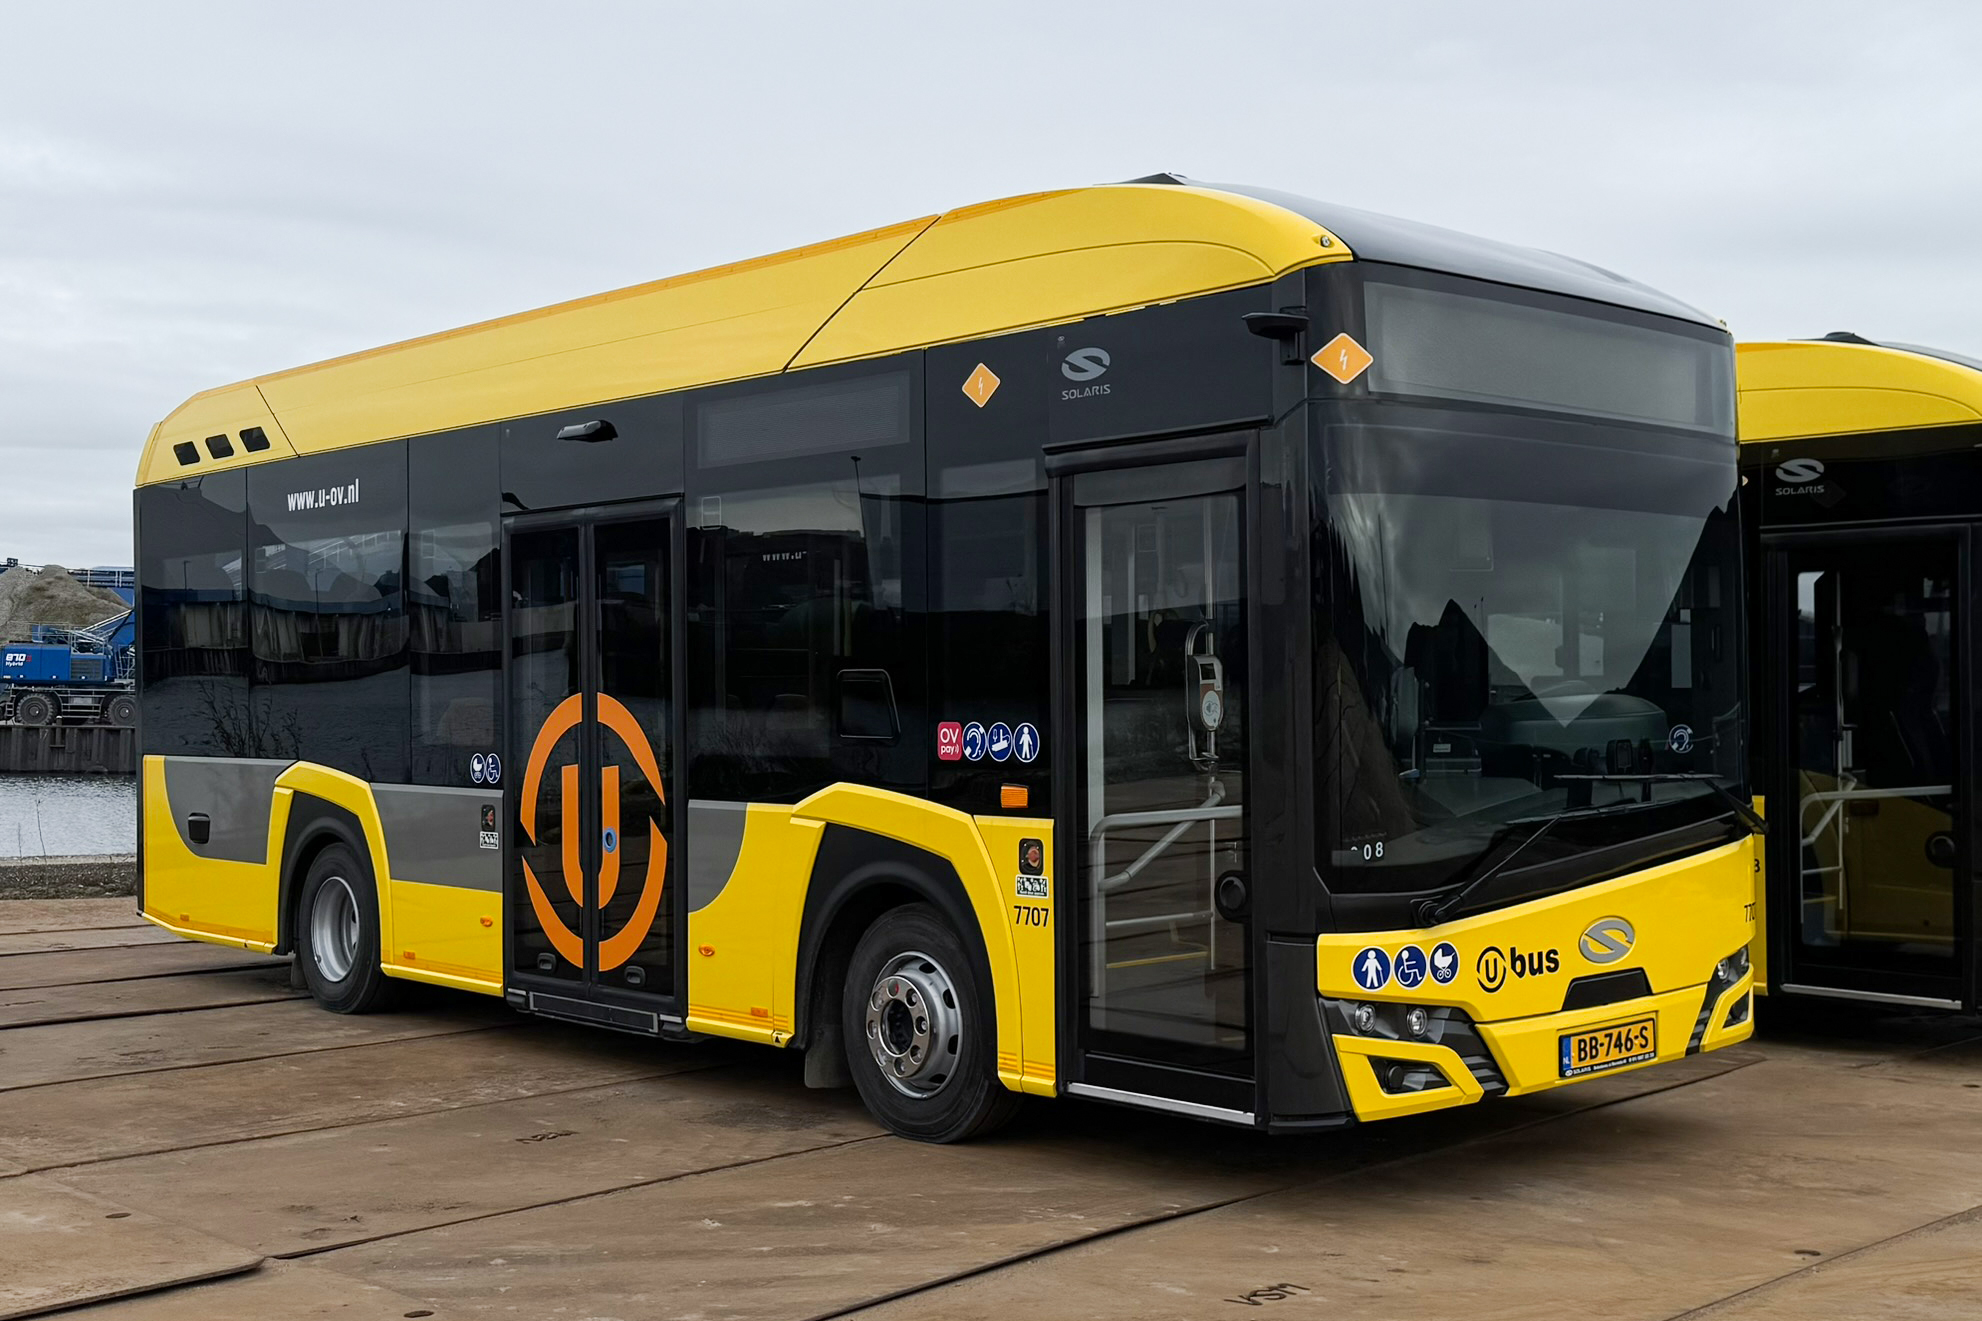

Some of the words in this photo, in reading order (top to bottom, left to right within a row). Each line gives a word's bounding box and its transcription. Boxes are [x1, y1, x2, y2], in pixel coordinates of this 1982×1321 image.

[1062, 384, 1111, 400] SOLARIS
[287, 478, 359, 511] www.u-ov.nl
[1775, 485, 1825, 496] SOLARIS
[6, 653, 26, 661] 870
[940, 728, 959, 743] OV
[940, 745, 954, 755] pay
[1014, 904, 1049, 927] 7707
[1510, 947, 1560, 979] bus
[1578, 1026, 1649, 1062] BB-746-S
